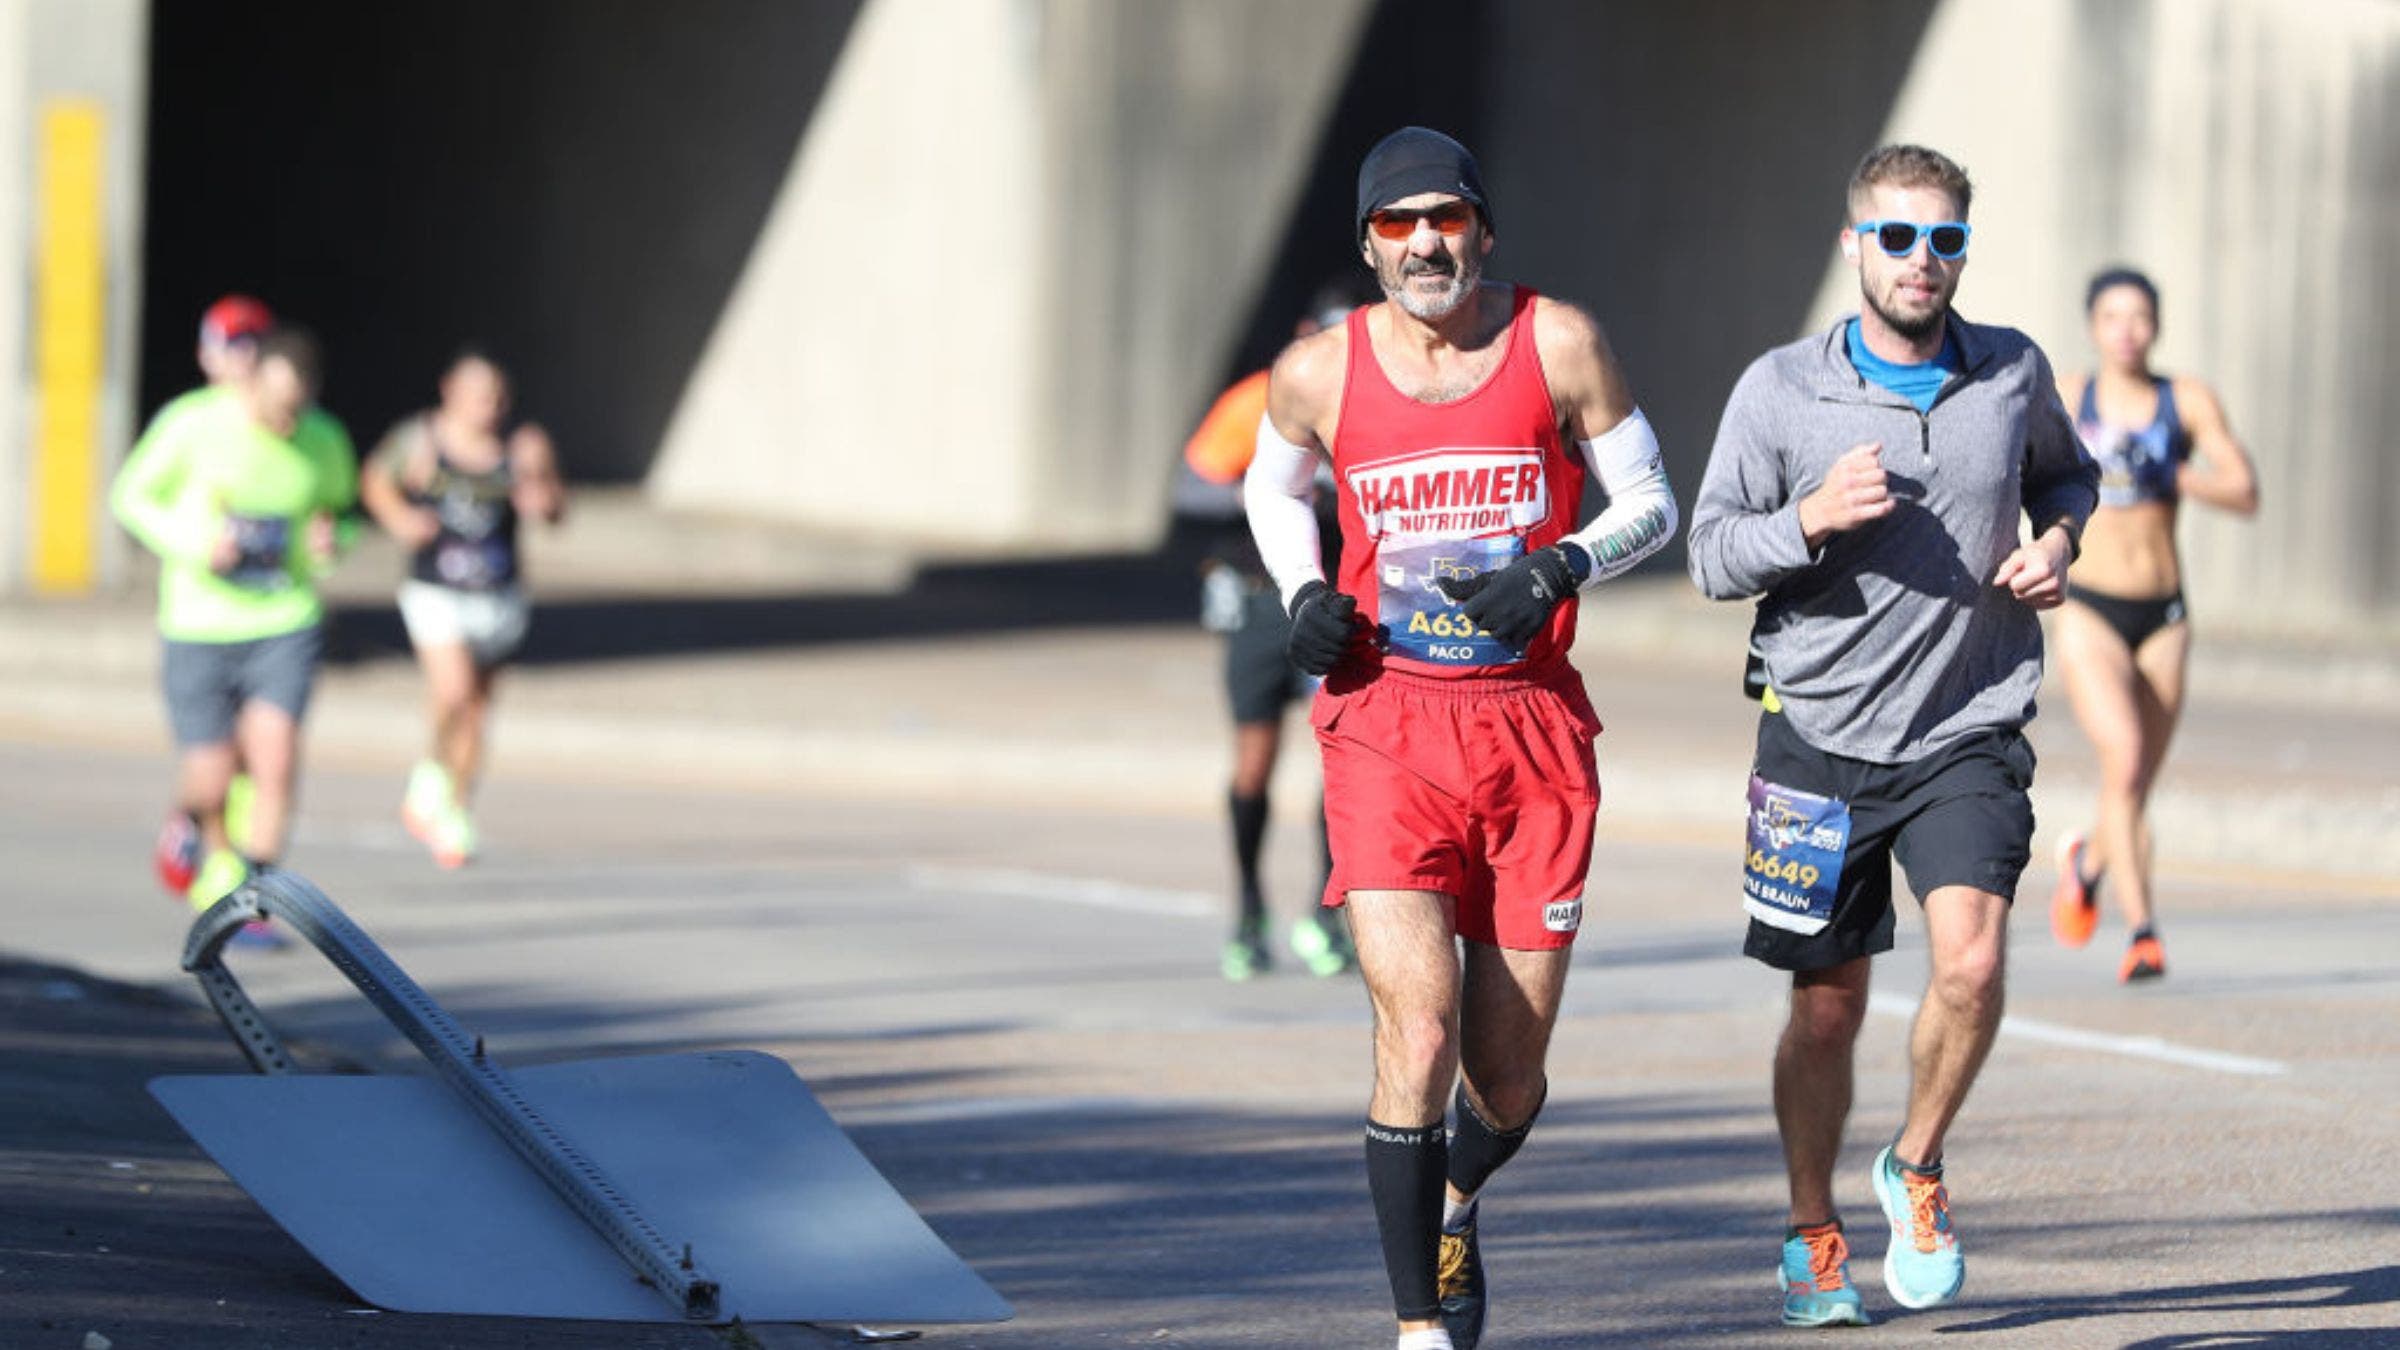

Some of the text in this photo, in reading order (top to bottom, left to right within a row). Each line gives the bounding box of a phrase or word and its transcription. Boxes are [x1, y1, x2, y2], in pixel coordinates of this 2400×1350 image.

[1359, 464, 1541, 514] HAMMER
[1400, 510, 1505, 533] NUTRITION
[1408, 611, 1491, 638] A63
[1429, 644, 1473, 659] PACO
[1761, 885, 1810, 911] BRAUN
